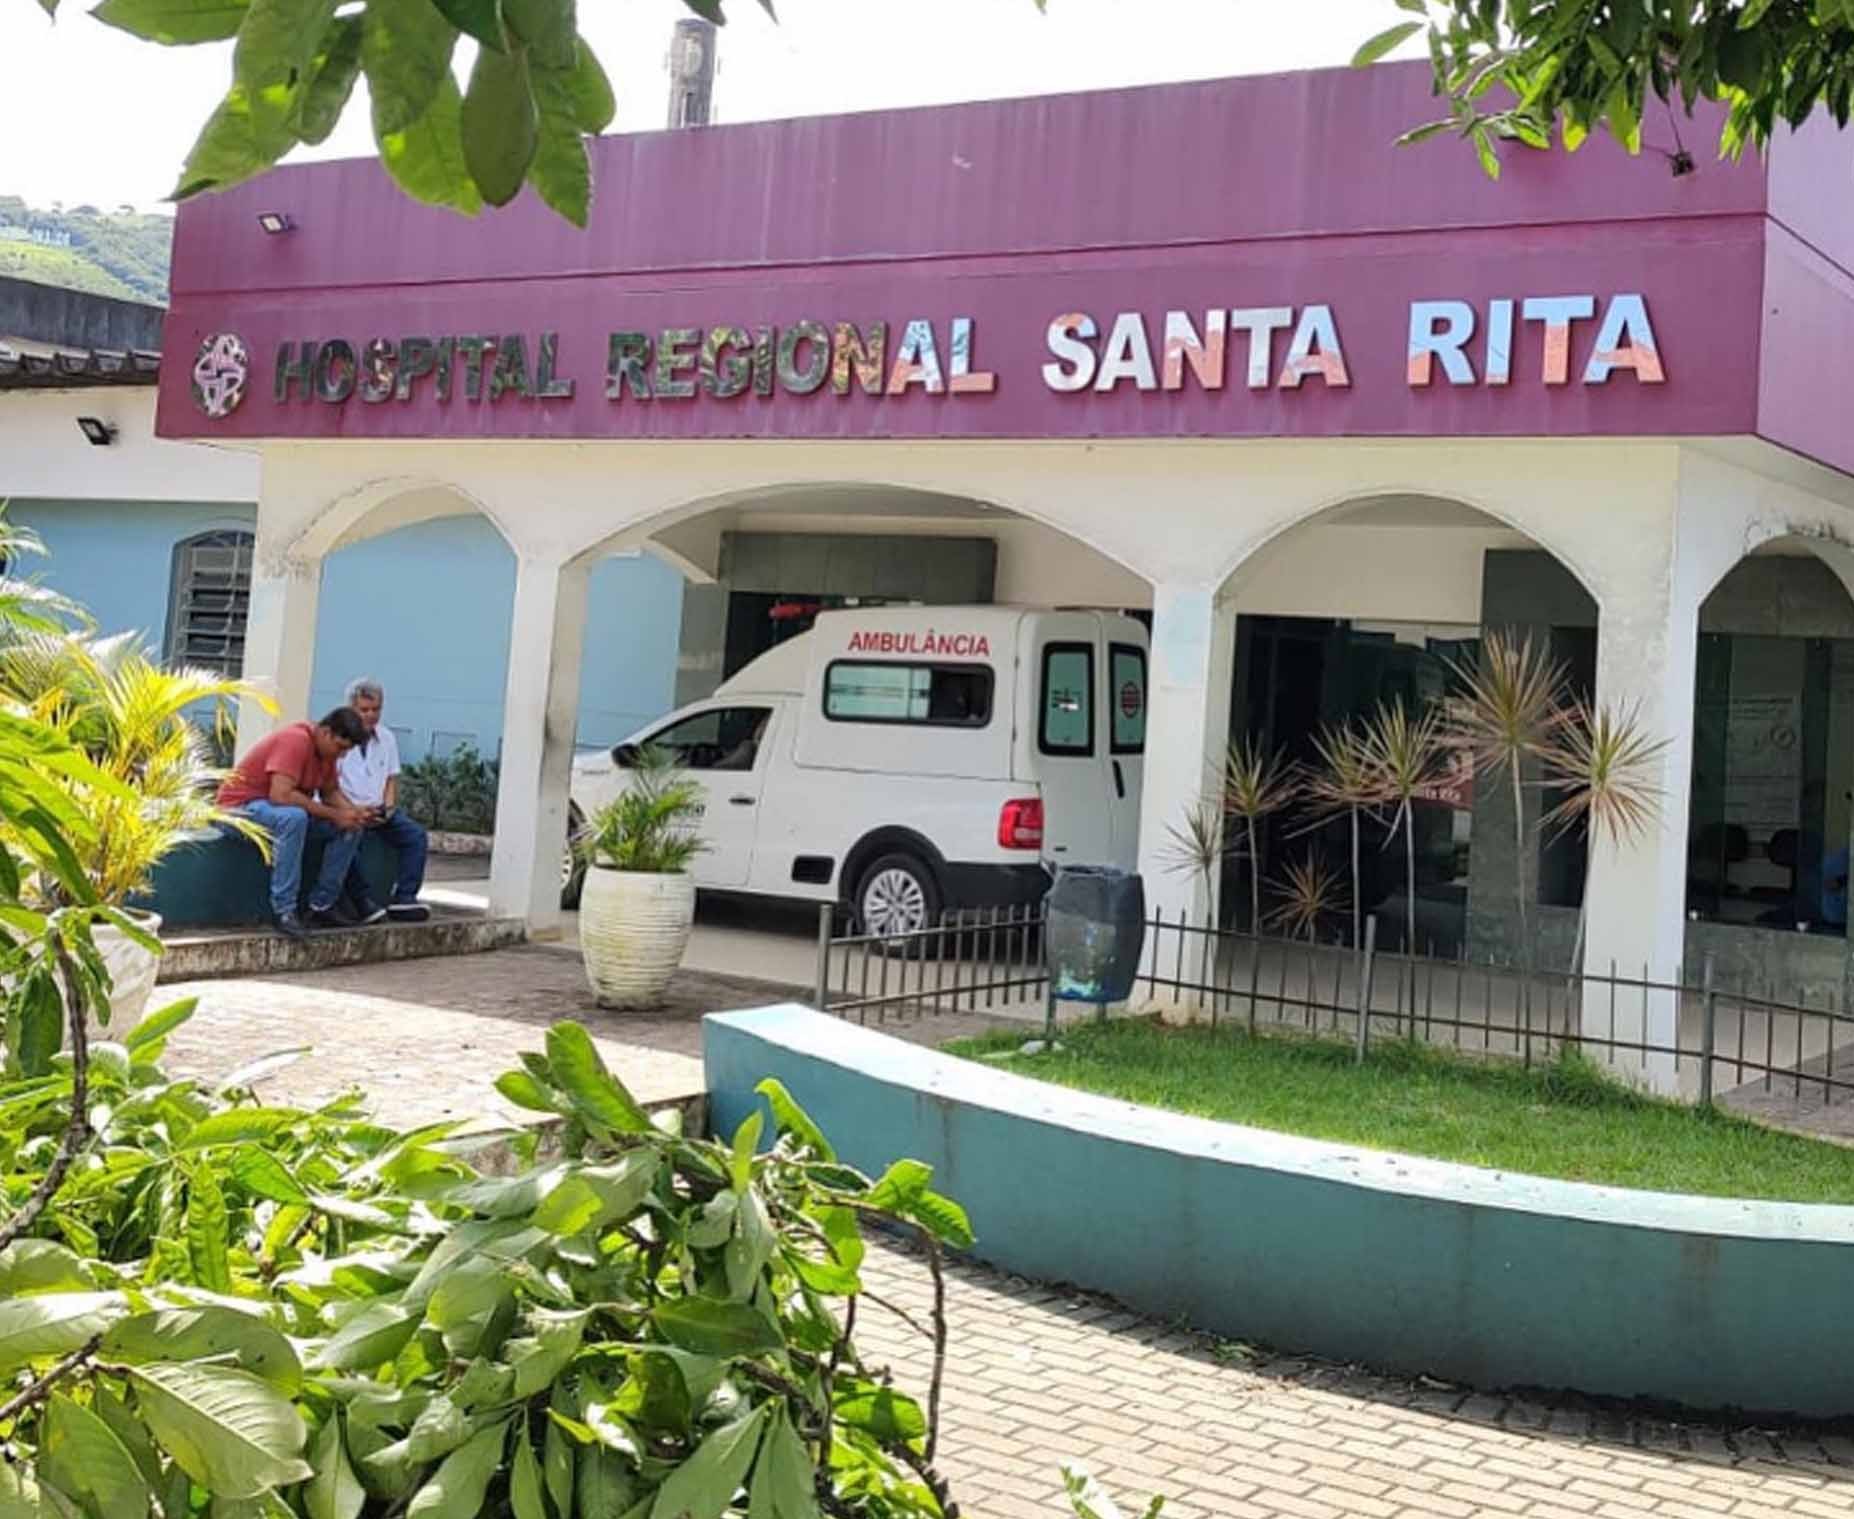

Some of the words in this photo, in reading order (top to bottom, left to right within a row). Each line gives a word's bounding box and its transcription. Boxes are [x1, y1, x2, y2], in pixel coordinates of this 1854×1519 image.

[274, 331, 575, 403] HOSPITAL
[605, 317, 998, 401] REGIONAL
[1041, 304, 1350, 391] SANTA
[1406, 293, 1666, 387] RITA
[847, 628, 990, 656] AMBULÂNCIA
